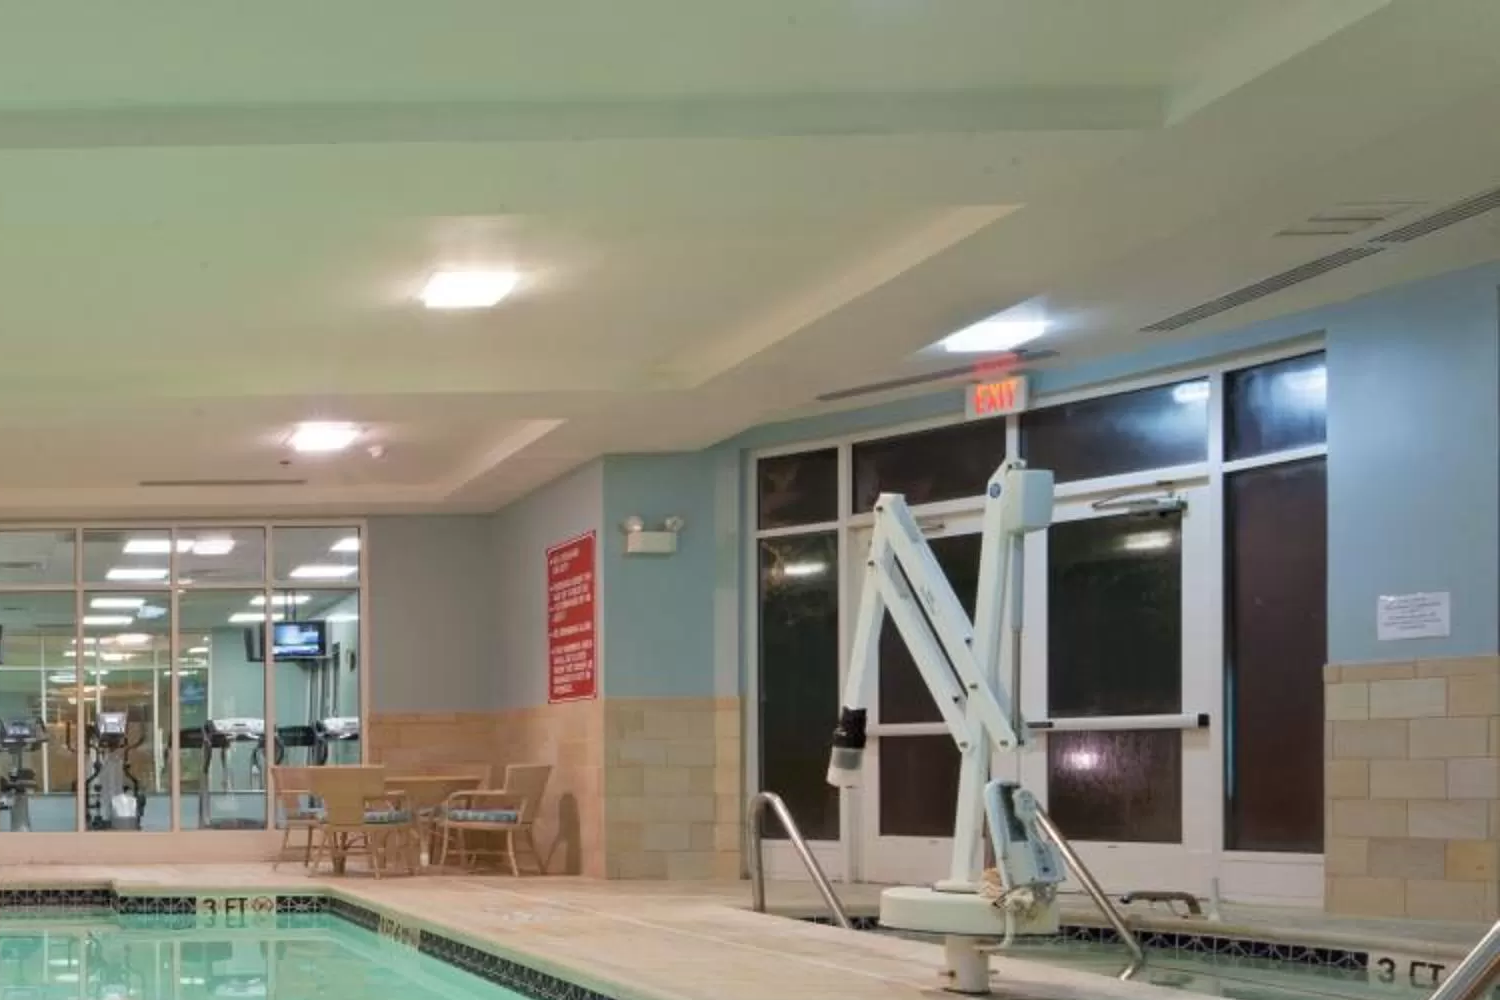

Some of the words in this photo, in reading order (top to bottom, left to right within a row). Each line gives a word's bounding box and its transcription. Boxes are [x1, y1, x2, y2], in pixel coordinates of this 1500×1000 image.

[975, 380, 1015, 416] EXIT
[203, 898, 216, 914] 3
[225, 897, 248, 915] FT
[1377, 958, 1395, 984] 3
